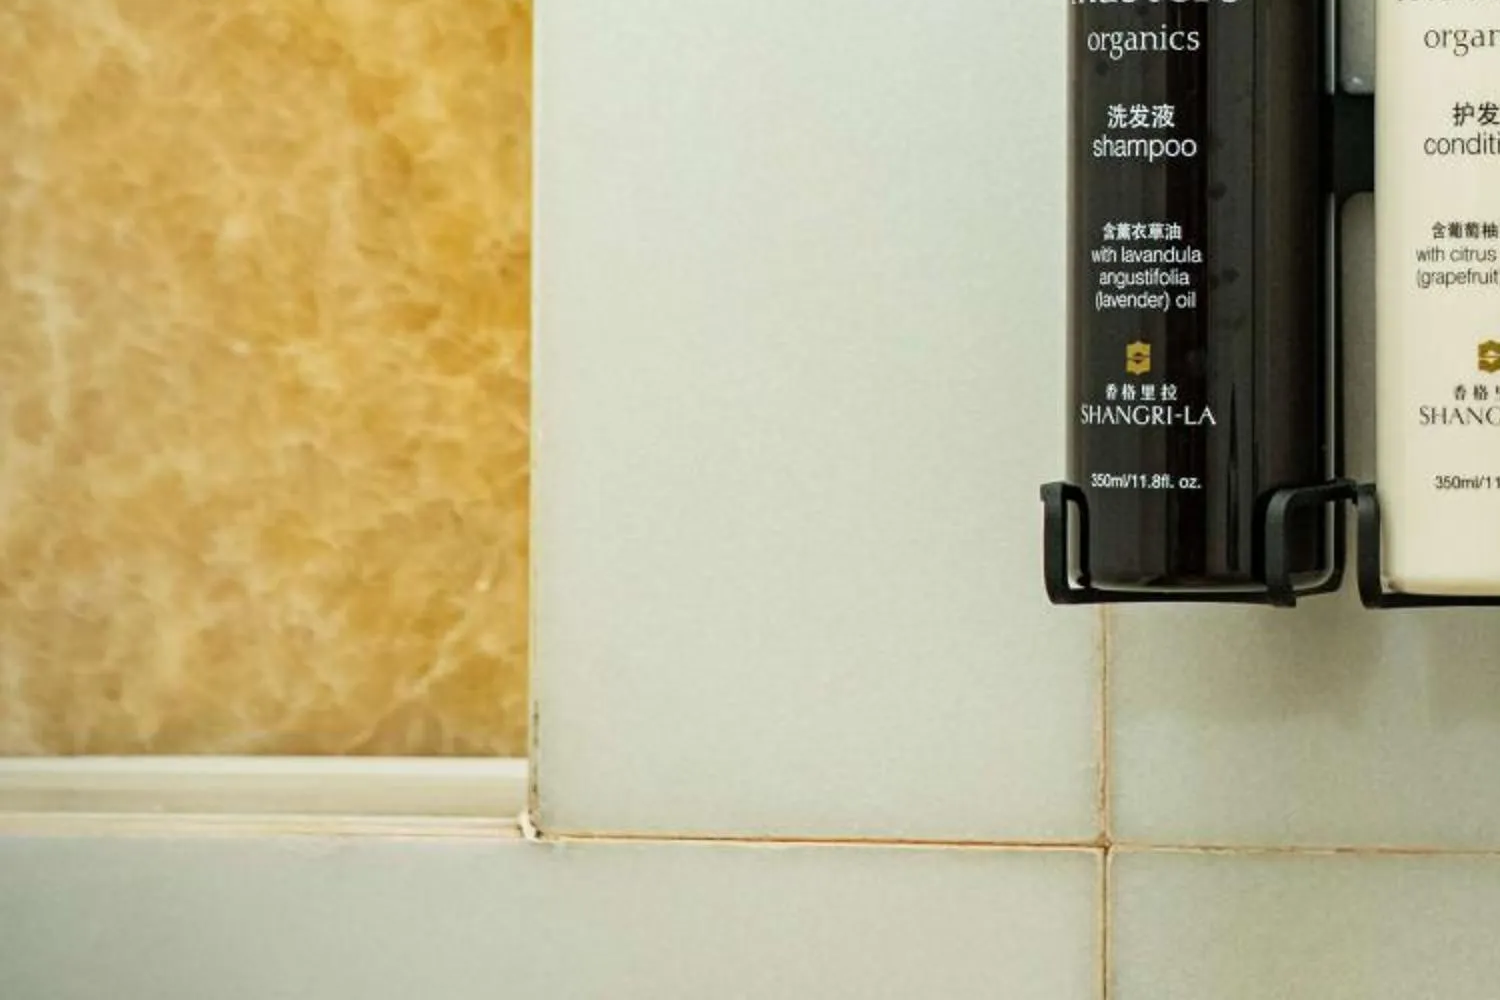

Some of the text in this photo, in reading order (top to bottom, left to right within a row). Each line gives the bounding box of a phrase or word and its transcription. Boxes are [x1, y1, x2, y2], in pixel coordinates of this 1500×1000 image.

[1087, 23, 1200, 60] organics
[1107, 104, 1175, 128] 洗发液
[1093, 134, 1197, 162] shampoo
[1091, 246, 1203, 263] with lavandula
[1416, 246, 1445, 262] with
[1450, 246, 1497, 263] citrus
[1099, 269, 1190, 288] angustifolia
[1095, 291, 1196, 311] (lavender) oil
[1105, 384, 1178, 401] 香格里拉
[1081, 404, 1216, 425] SHANGRI-LA
[1091, 474, 1201, 489] 350ml/11.8fl. oz.
